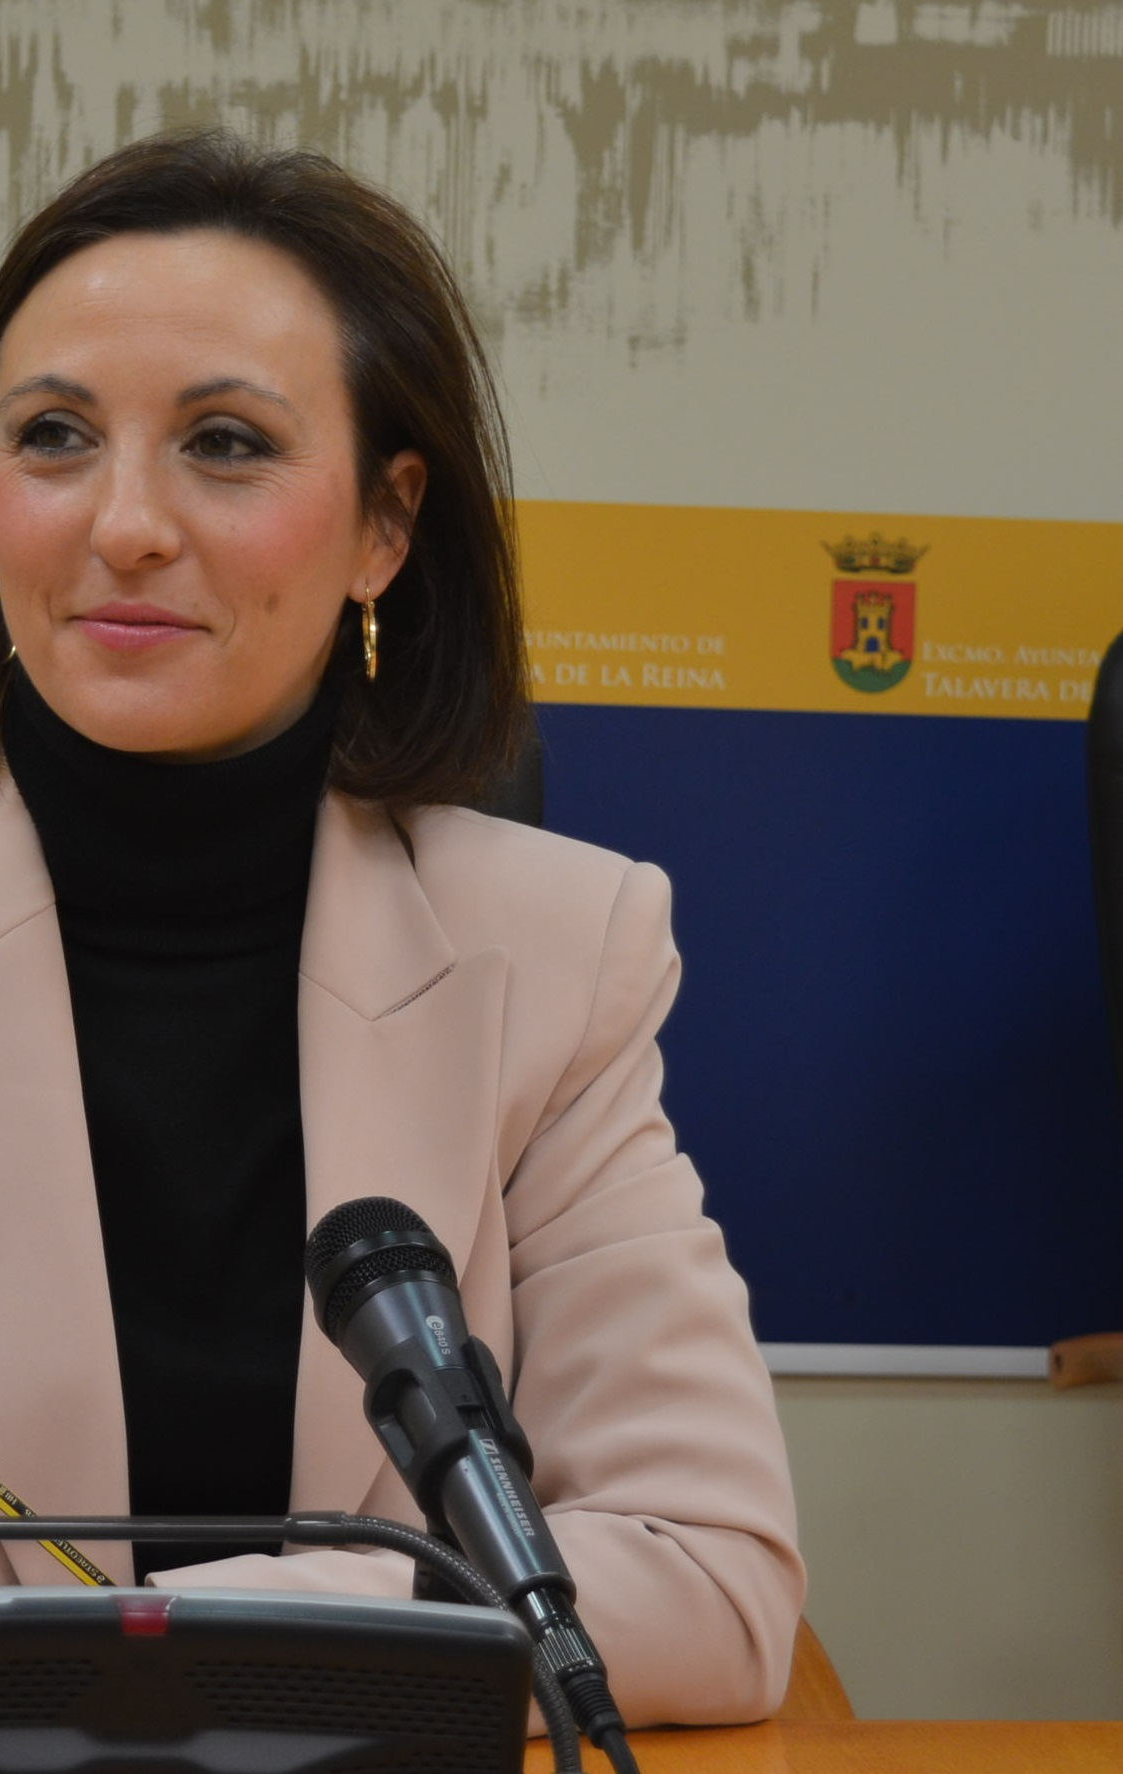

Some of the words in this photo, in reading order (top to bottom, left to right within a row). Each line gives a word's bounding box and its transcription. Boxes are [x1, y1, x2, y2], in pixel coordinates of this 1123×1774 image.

[525, 629, 691, 654] YUNTAMIENTO
[697, 634, 726, 656] DE
[555, 662, 589, 686] DE
[600, 664, 632, 688] LA
[641, 662, 726, 691] REINA
[921, 672, 1051, 702] TALAVERA
[490, 1456, 534, 1535] SENNHEISER
